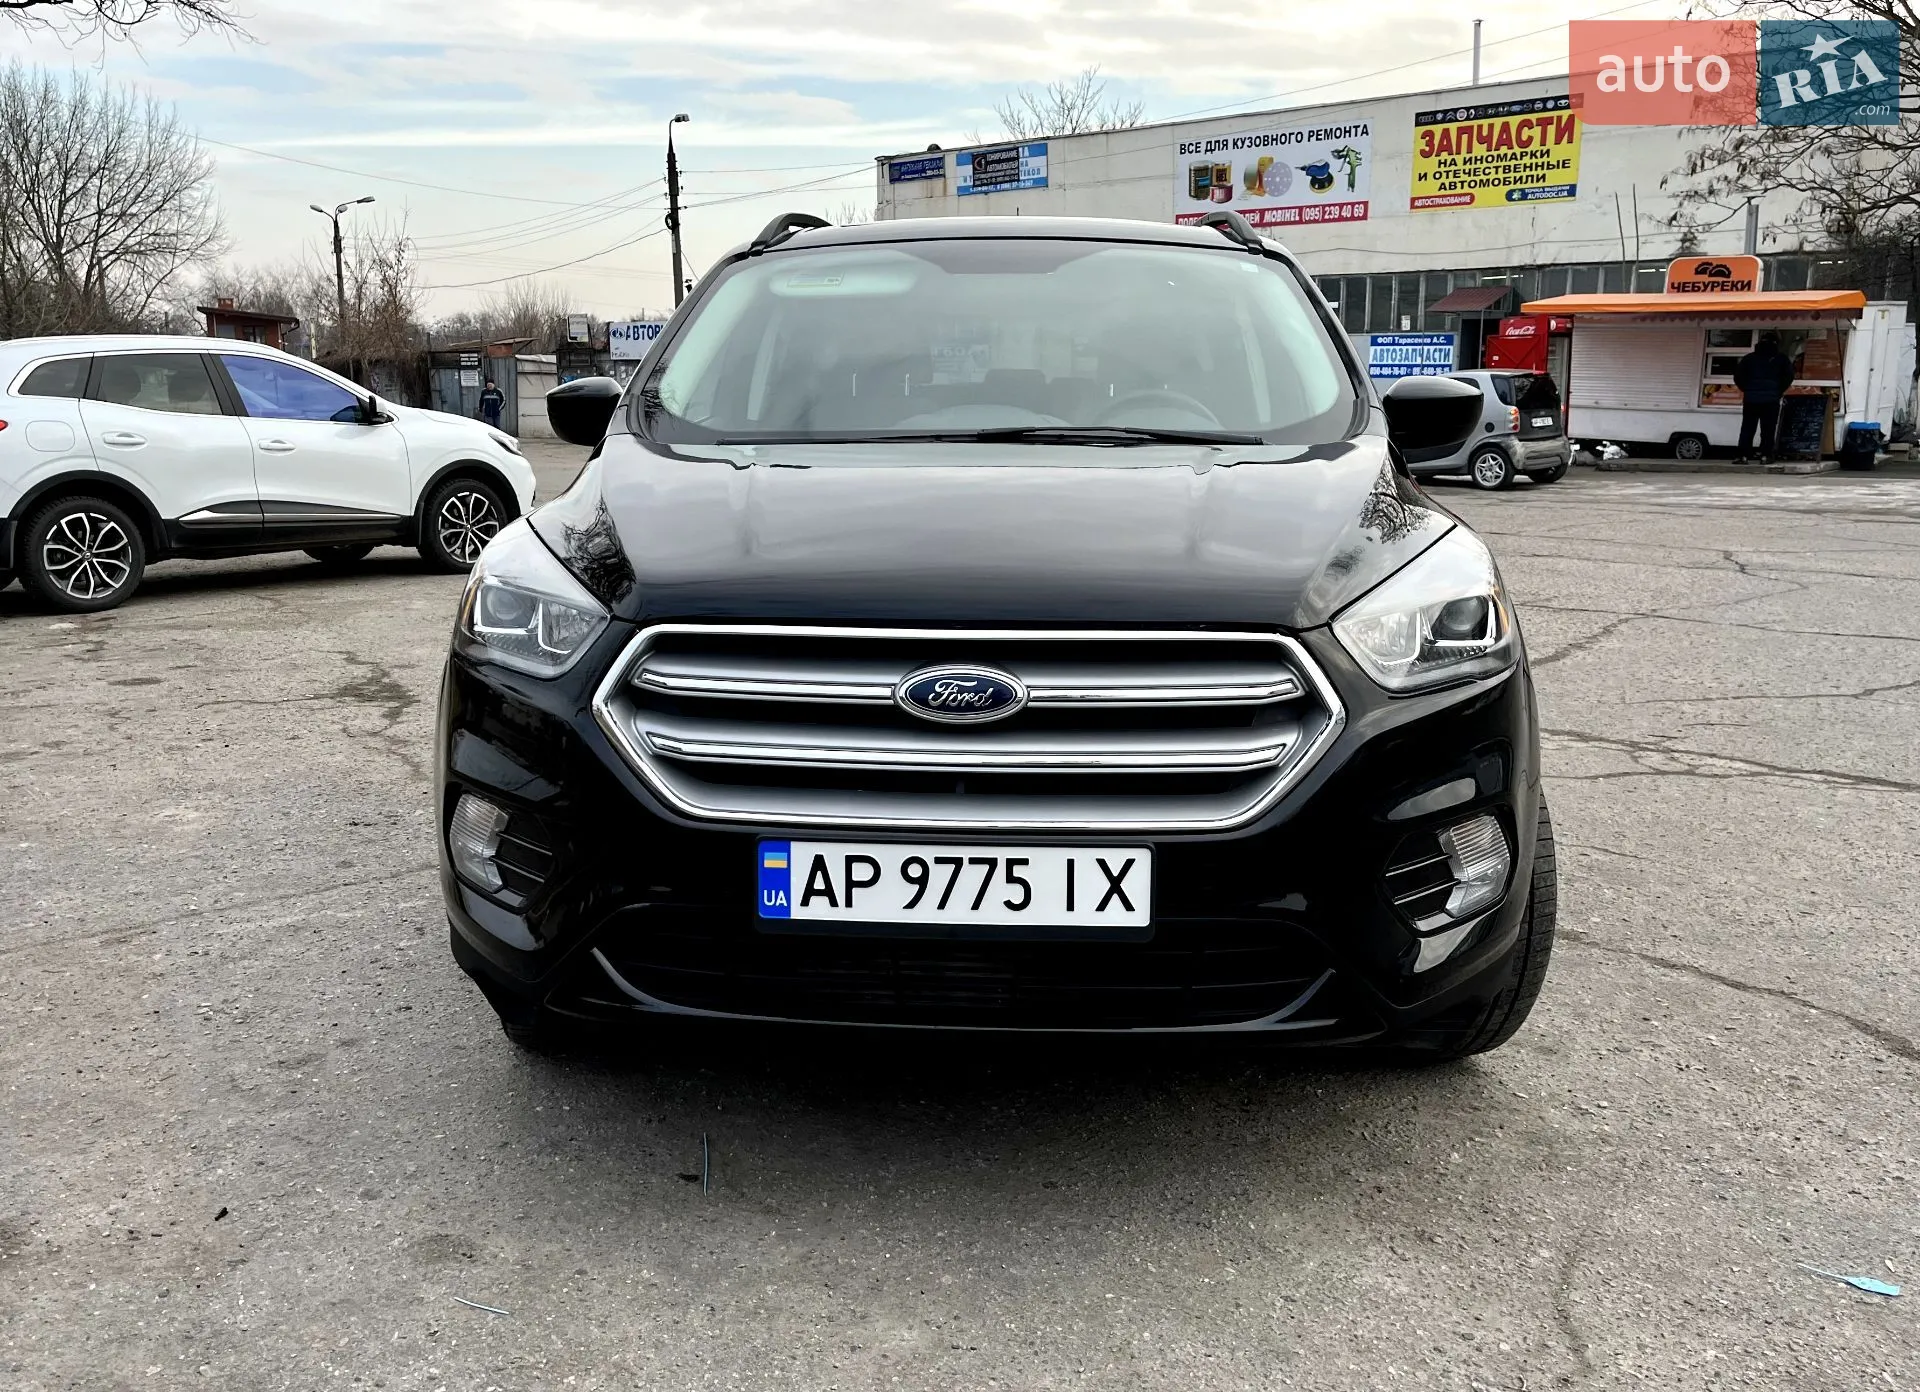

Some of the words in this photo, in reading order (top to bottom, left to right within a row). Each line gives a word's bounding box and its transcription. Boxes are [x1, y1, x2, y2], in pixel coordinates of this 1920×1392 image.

[1179, 141, 1201, 155] ВСЕ
[1204, 139, 1229, 155] ДЛЯ
[1232, 131, 1304, 150] КУЗОВНОГО
[1307, 123, 1370, 143] РЕМОНТА
[1419, 113, 1576, 159] ЗАПЧАСТИ
[1438, 156, 1458, 169] НА
[1462, 149, 1551, 167] ИНОМАРКИ
[1418, 172, 1428, 182] И
[1432, 159, 1571, 181] ОТЕЧЕСТВЕННЫЕ
[1437, 174, 1547, 192] АВТОМОБИЛИ
[1414, 195, 1473, 208] АВТОСТРАХОВАНИЕ
[1527, 190, 1569, 201] AUTODOC.UA
[1263, 207, 1300, 223] MOBIHEL
[1302, 205, 1323, 222] (095)
[1324, 204, 1340, 219] 239
[1341, 204, 1352, 218] 40
[1353, 203, 1365, 217] 69
[1670, 280, 1752, 293] ЧЕБУРЕКИ
[625, 324, 664, 341] АВТОР
[1505, 325, 1536, 336] Coca-Cola
[1377, 336, 1393, 344] ФОП
[1371, 347, 1451, 363] АВТОЗАПЧАСТИ
[928, 679, 993, 707] Ford
[800, 854, 882, 909] AP
[900, 856, 1032, 912] 9775
[1066, 857, 1136, 912] IX
[763, 889, 788, 907] UA
